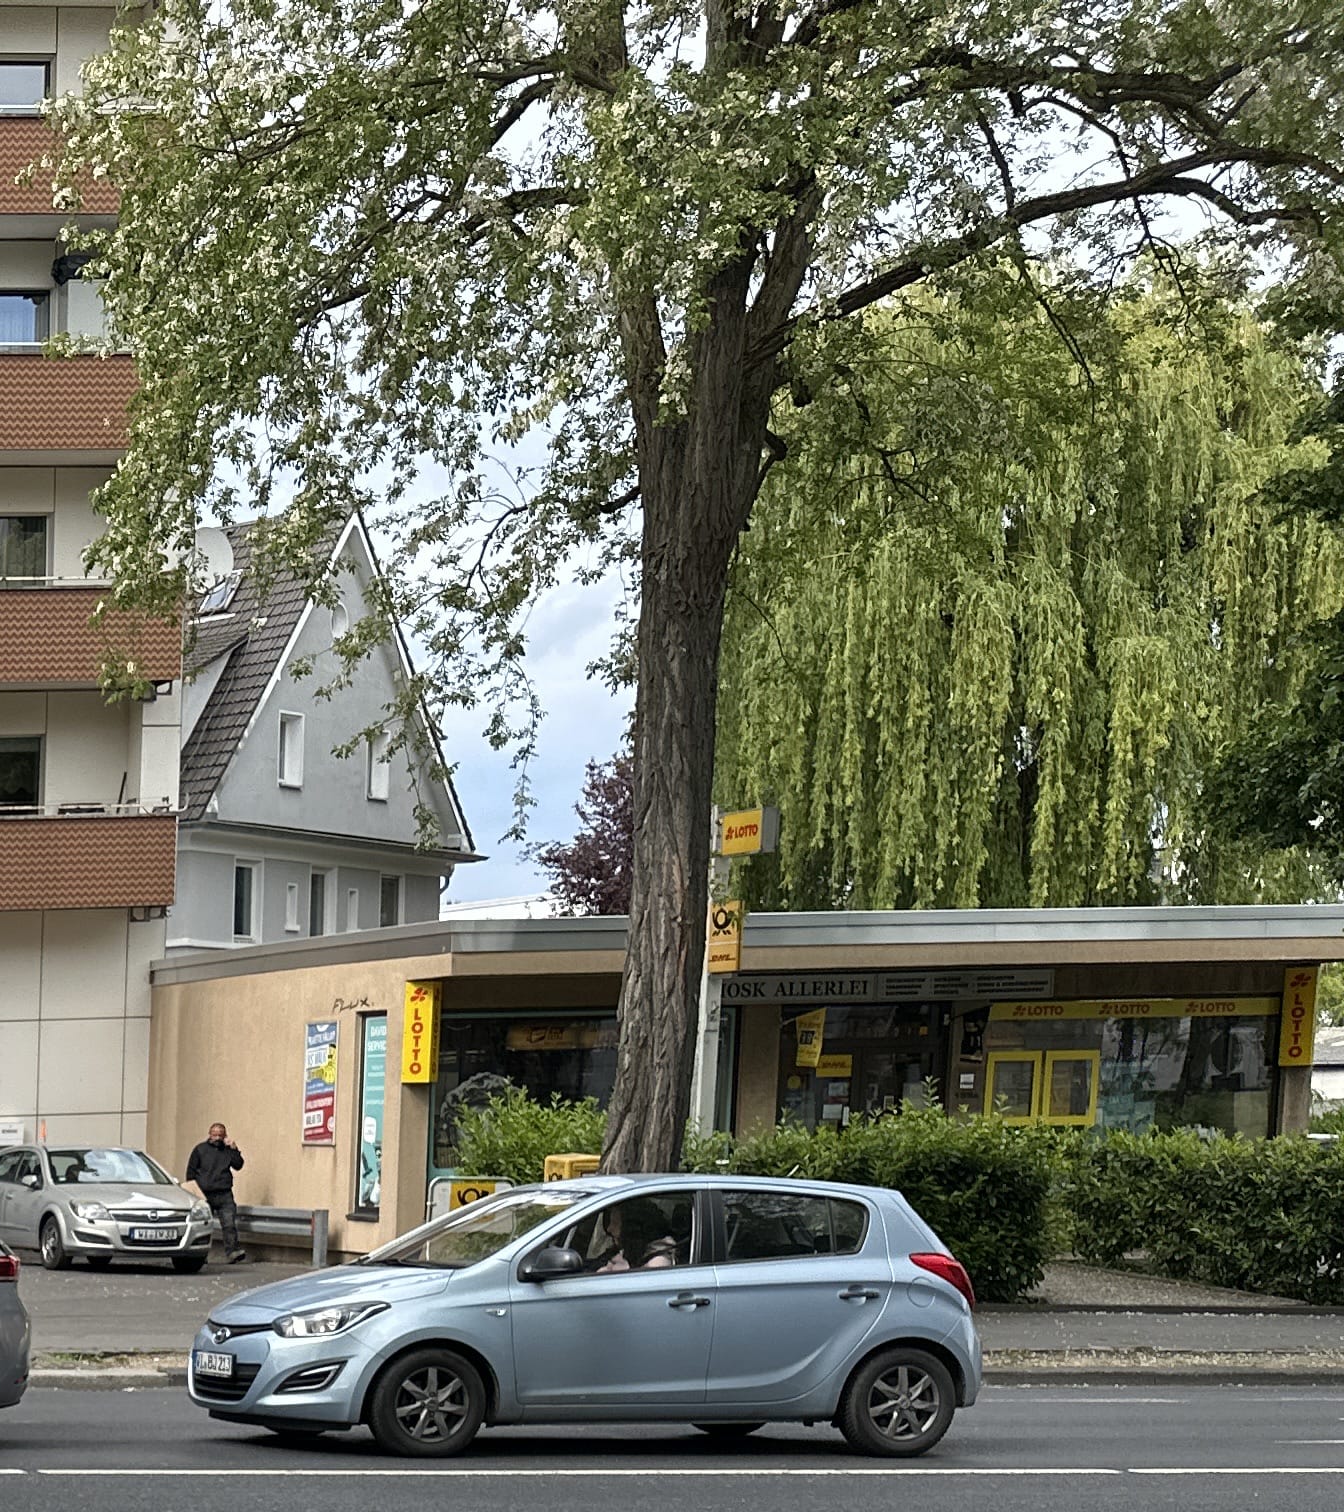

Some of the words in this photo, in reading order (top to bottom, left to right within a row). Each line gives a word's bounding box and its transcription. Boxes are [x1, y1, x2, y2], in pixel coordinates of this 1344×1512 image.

[735, 824, 759, 838] LOTTO
[721, 982, 765, 998] IOSK
[775, 980, 868, 997] ALLERLEI
[1027, 1004, 1064, 1016] LOTTO
[1114, 1003, 1150, 1014] LOTTO
[1200, 1001, 1235, 1012] LOTTO
[1289, 994, 1305, 1058] LOTTO
[409, 1008, 424, 1074] LOTTO
